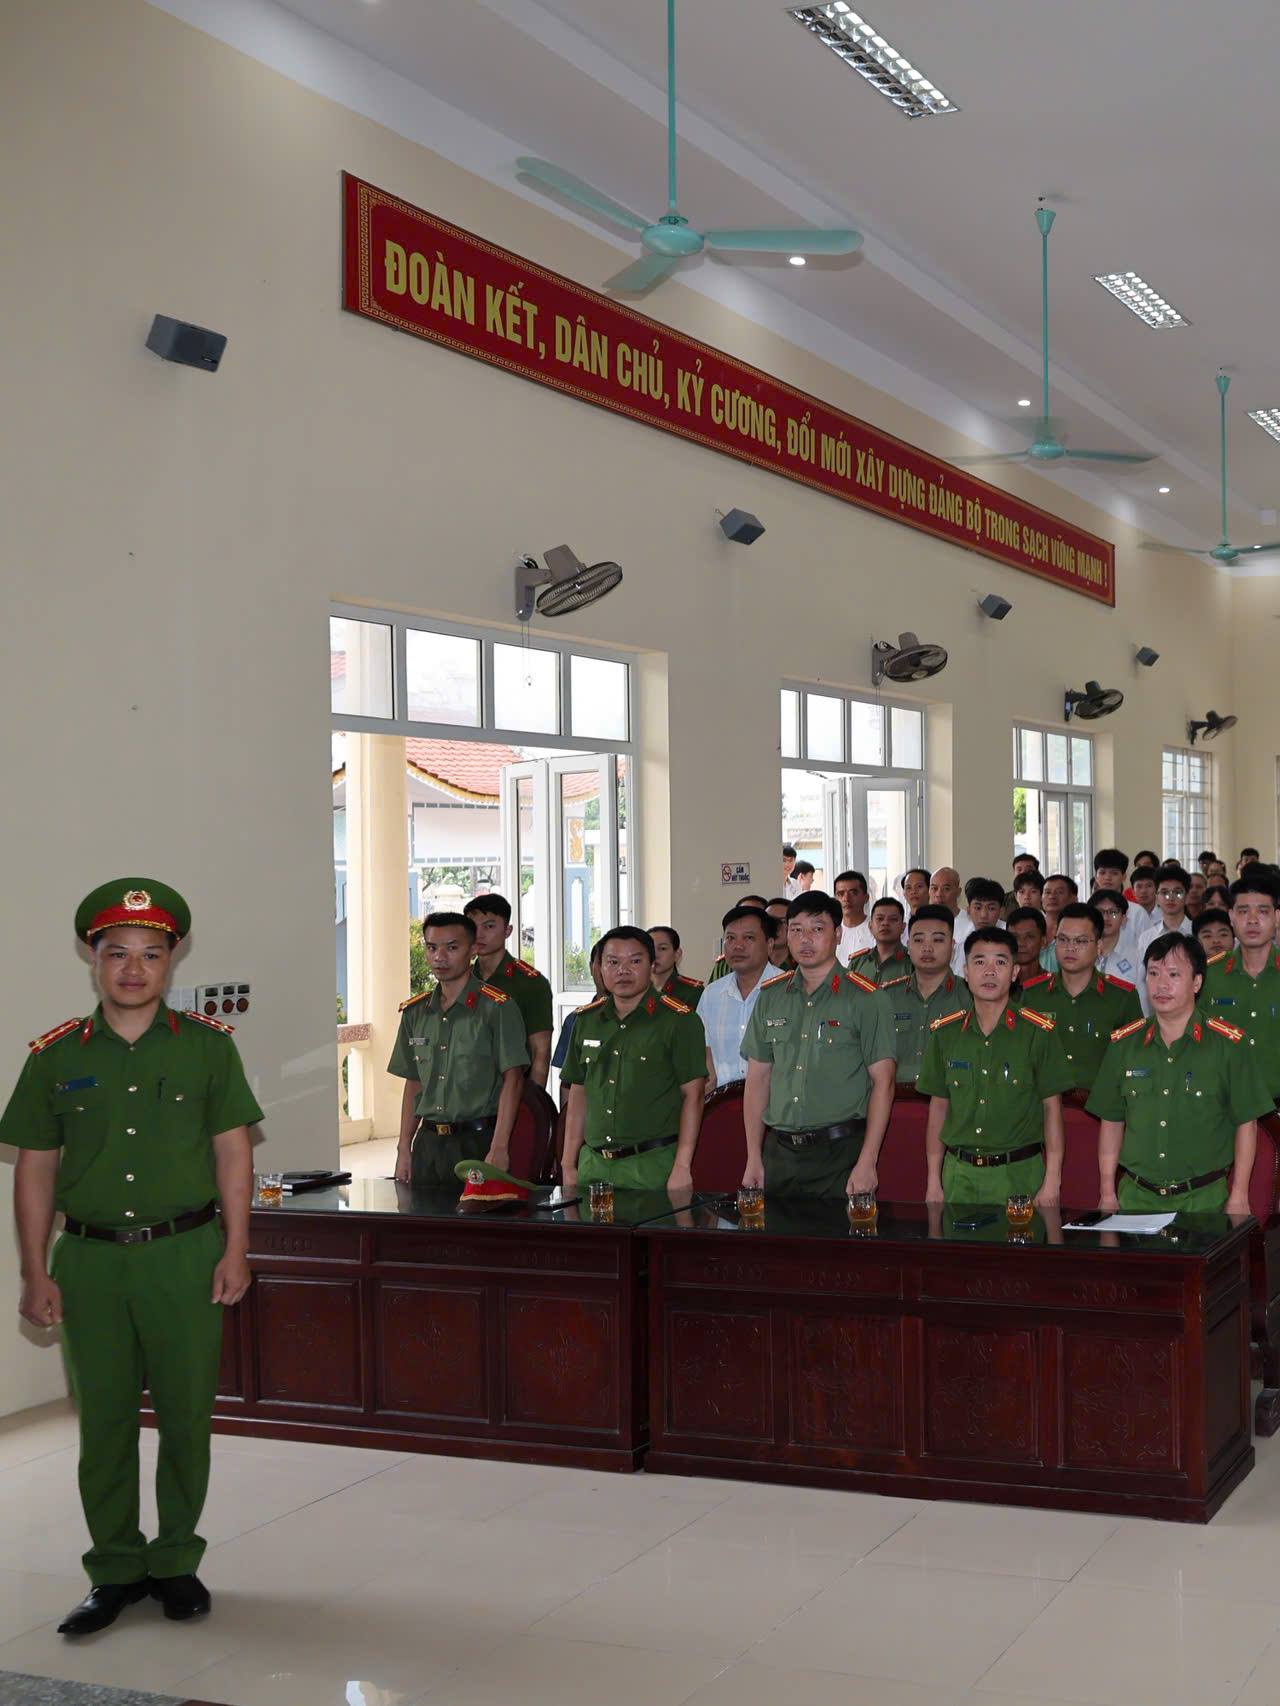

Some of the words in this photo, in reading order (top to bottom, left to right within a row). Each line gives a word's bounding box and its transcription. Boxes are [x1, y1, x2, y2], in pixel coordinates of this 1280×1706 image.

[385, 239, 475, 326] ĐOÀN
[486, 281, 546, 360] KẾT,
[555, 314, 608, 380] DÂN
[616, 338, 670, 409] CHỦ,
[677, 358, 705, 416] KỶ
[711, 383, 782, 454] CƯƠNG,
[786, 410, 816, 465] ĐỔI
[821, 431, 852, 480] MỚI
[856, 447, 885, 493] XÂY
[888, 464, 926, 510] DỰNG
[928, 474, 963, 527] ĐẢNG
[966, 497, 982, 541] BỘ
[984, 508, 1020, 551] TRONG
[1022, 526, 1049, 563] SẠCH
[1051, 534, 1076, 575] VỮNG
[1077, 550, 1103, 586] MẠNH
